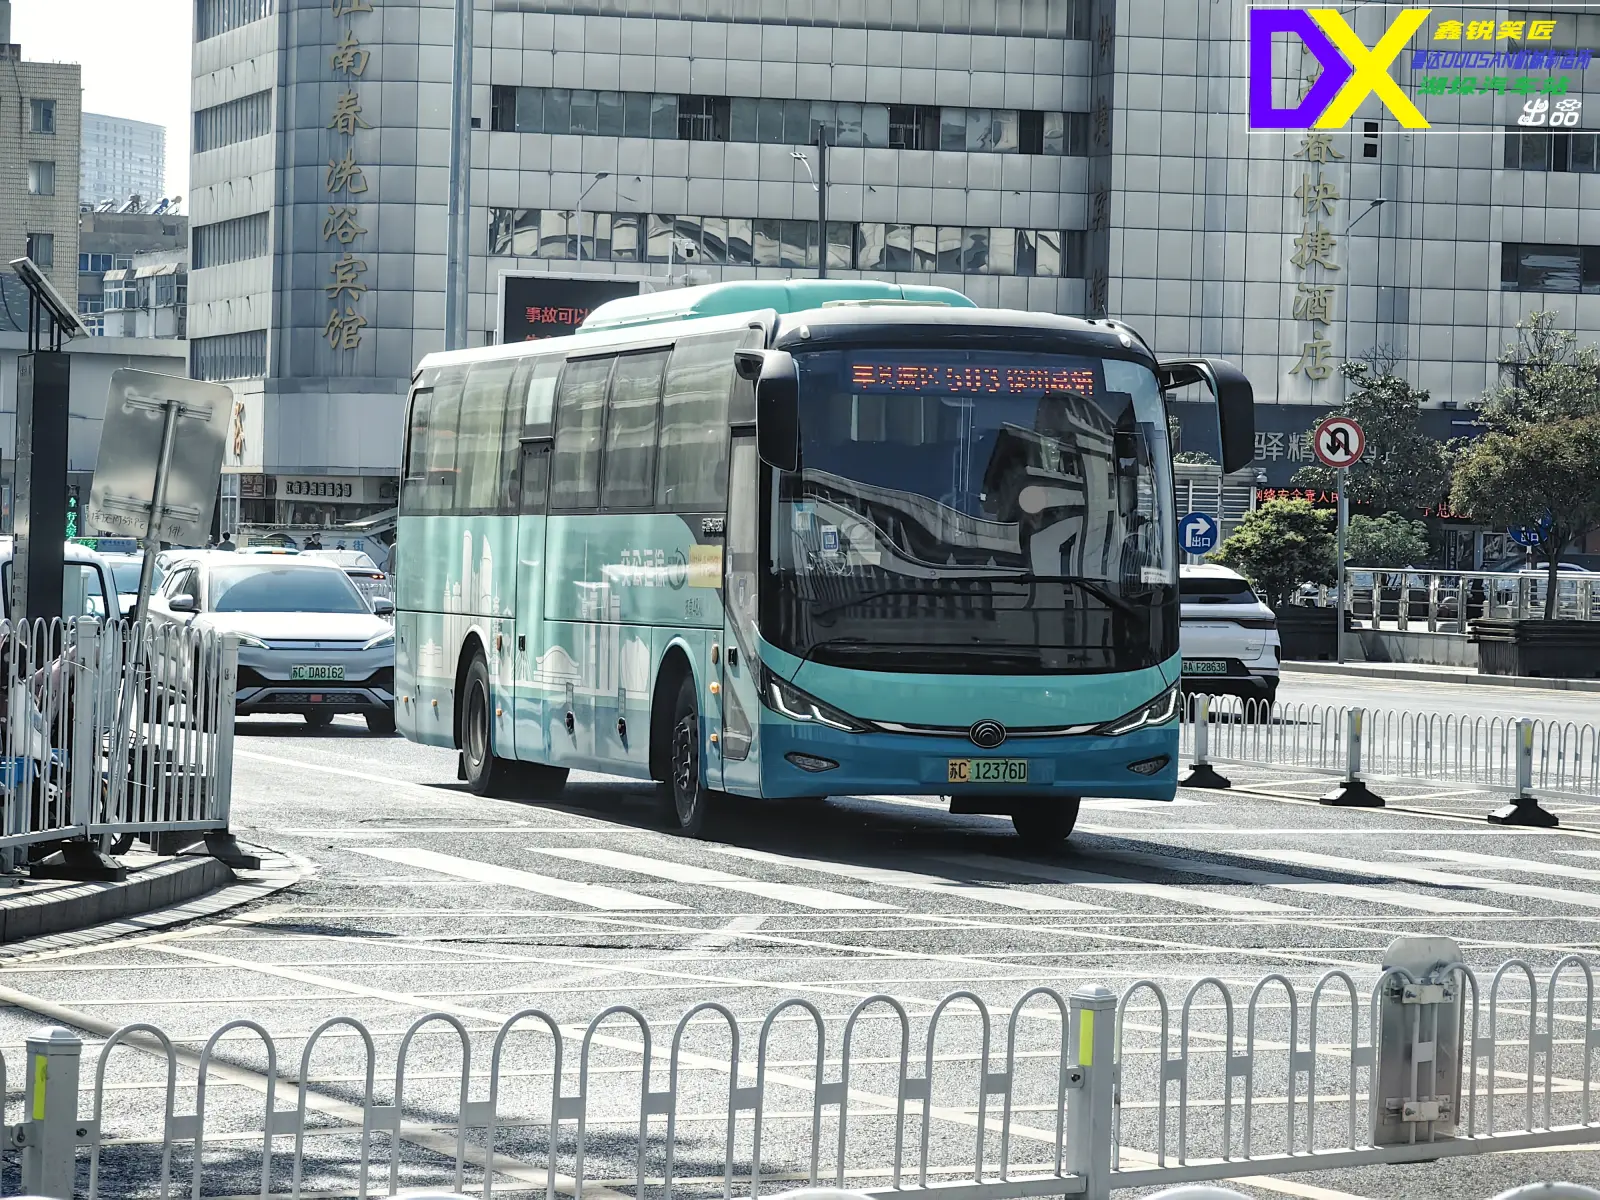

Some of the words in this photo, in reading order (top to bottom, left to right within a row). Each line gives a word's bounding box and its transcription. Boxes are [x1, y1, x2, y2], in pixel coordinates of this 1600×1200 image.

[525, 306, 588, 324] 事故可以
[1191, 536, 1211, 548] 出口
